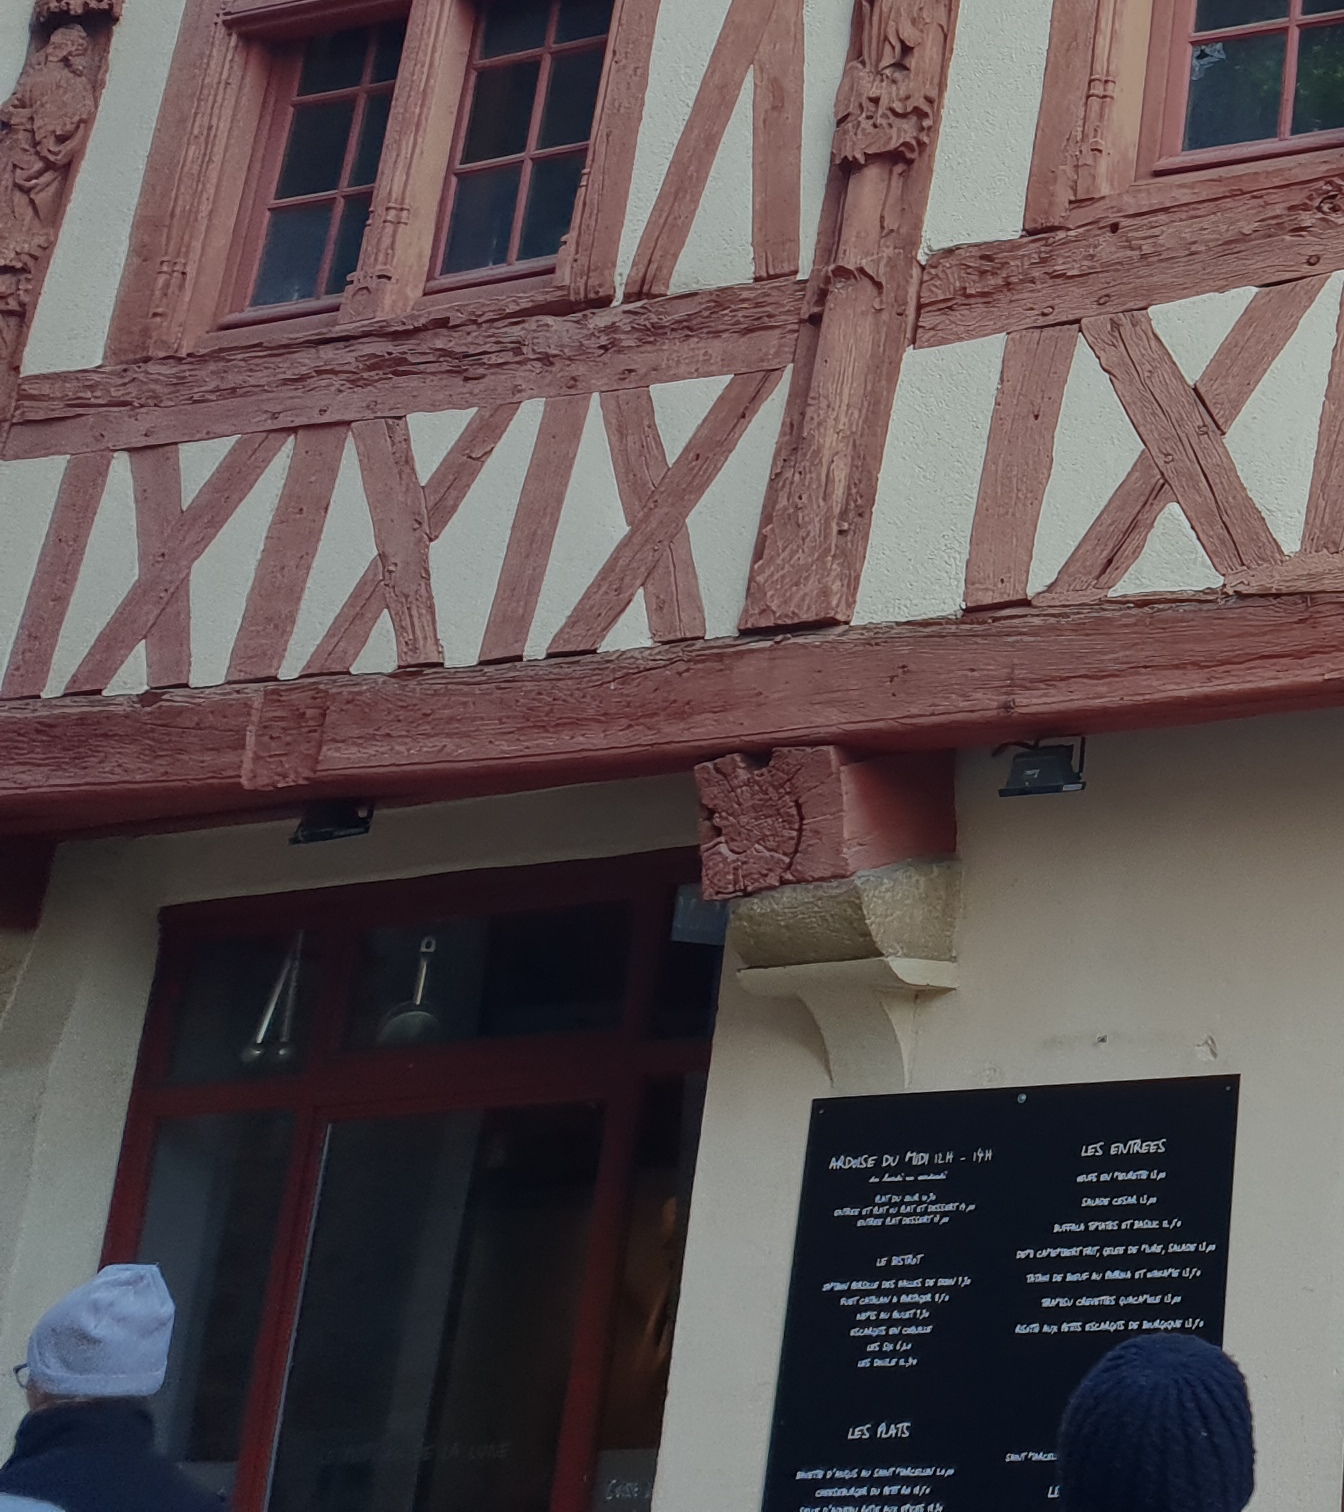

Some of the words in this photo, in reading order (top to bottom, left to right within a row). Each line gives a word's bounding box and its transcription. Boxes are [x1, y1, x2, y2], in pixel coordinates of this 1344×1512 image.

[1082, 1142, 1104, 1156] LES
[1110, 1139, 1166, 1154] ENTREES
[829, 1155, 877, 1169] ARDOISE
[882, 1155, 899, 1166] DU
[905, 1151, 929, 1165] MIDI
[848, 1424, 871, 1439] LES
[877, 1422, 911, 1437] PLATS
